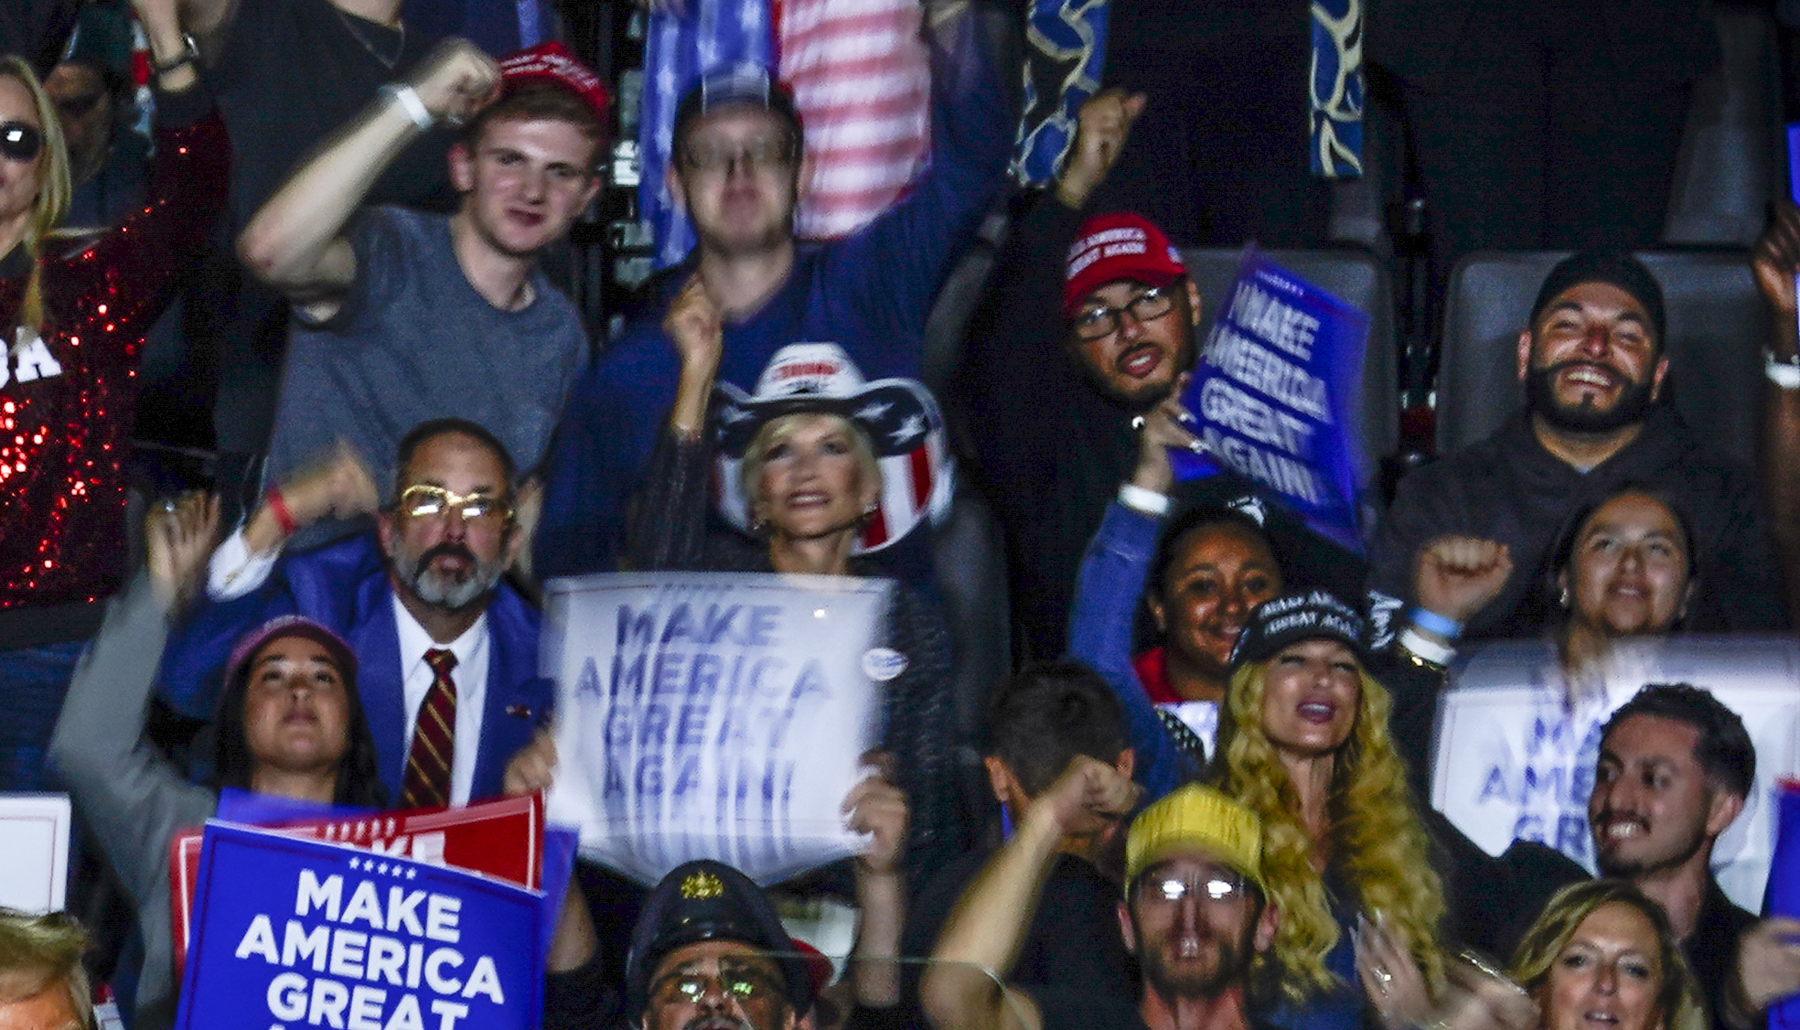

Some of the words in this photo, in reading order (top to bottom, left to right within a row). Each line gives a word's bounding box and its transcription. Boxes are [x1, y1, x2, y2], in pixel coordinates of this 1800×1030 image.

[616, 602, 782, 648] MAKE
[574, 652, 833, 703] AMERICA
[605, 704, 792, 748] GREAT
[296, 868, 462, 944] MAKE
[235, 914, 504, 1005] AMERICA
